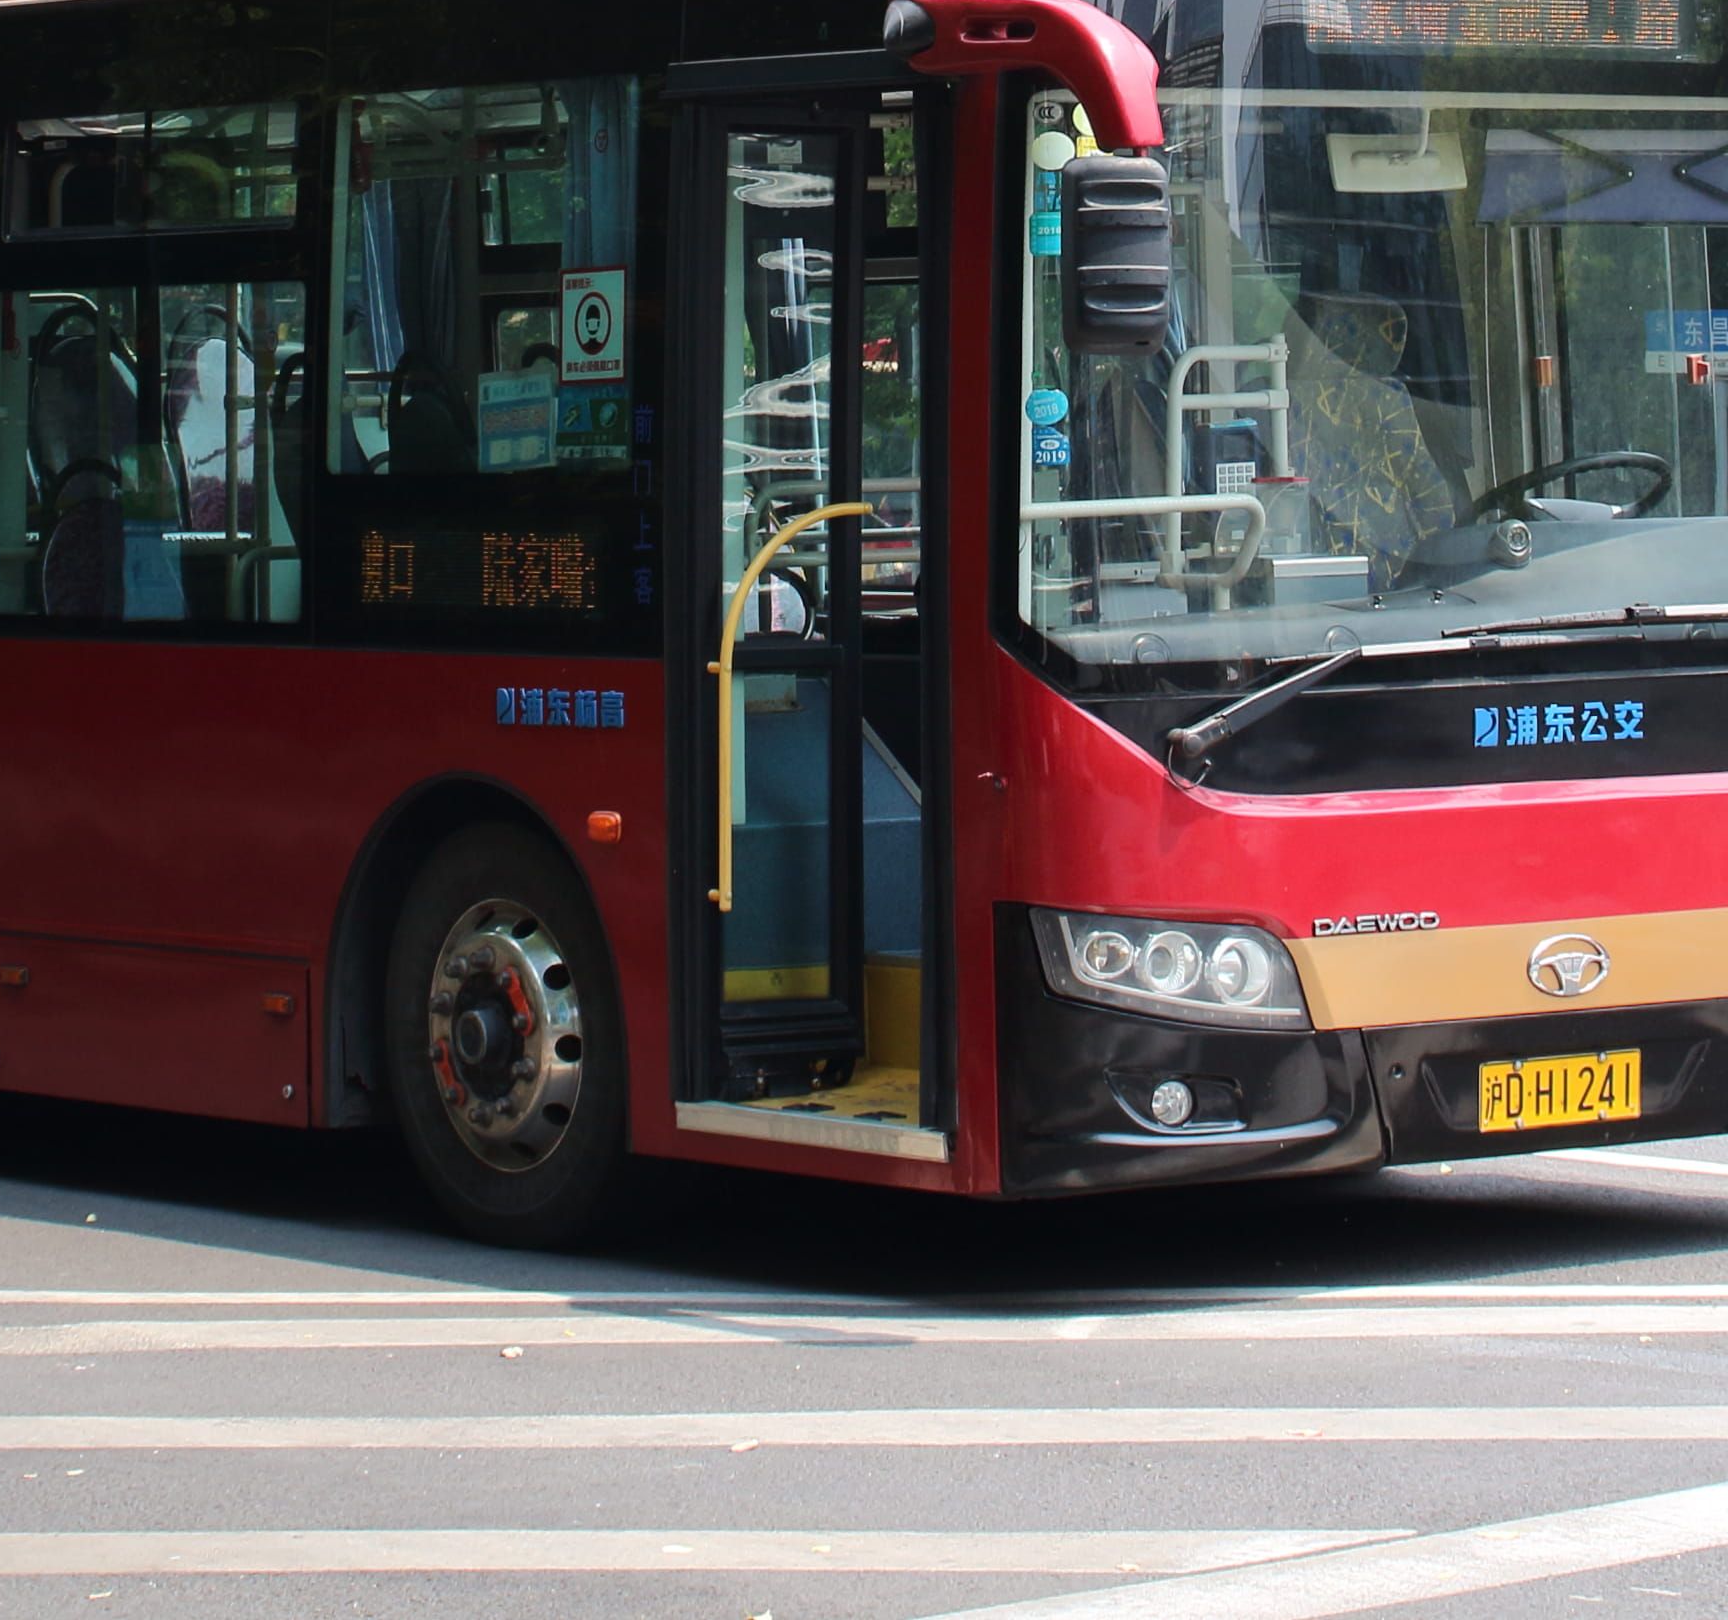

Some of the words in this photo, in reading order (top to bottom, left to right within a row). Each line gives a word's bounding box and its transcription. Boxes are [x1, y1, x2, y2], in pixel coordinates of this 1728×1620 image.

[1036, 451, 1066, 463] 2019
[520, 687, 625, 727] 浦东杨高
[1506, 701, 1644, 746] 浦东公交
[1314, 911, 1440, 936] DAEWOO
